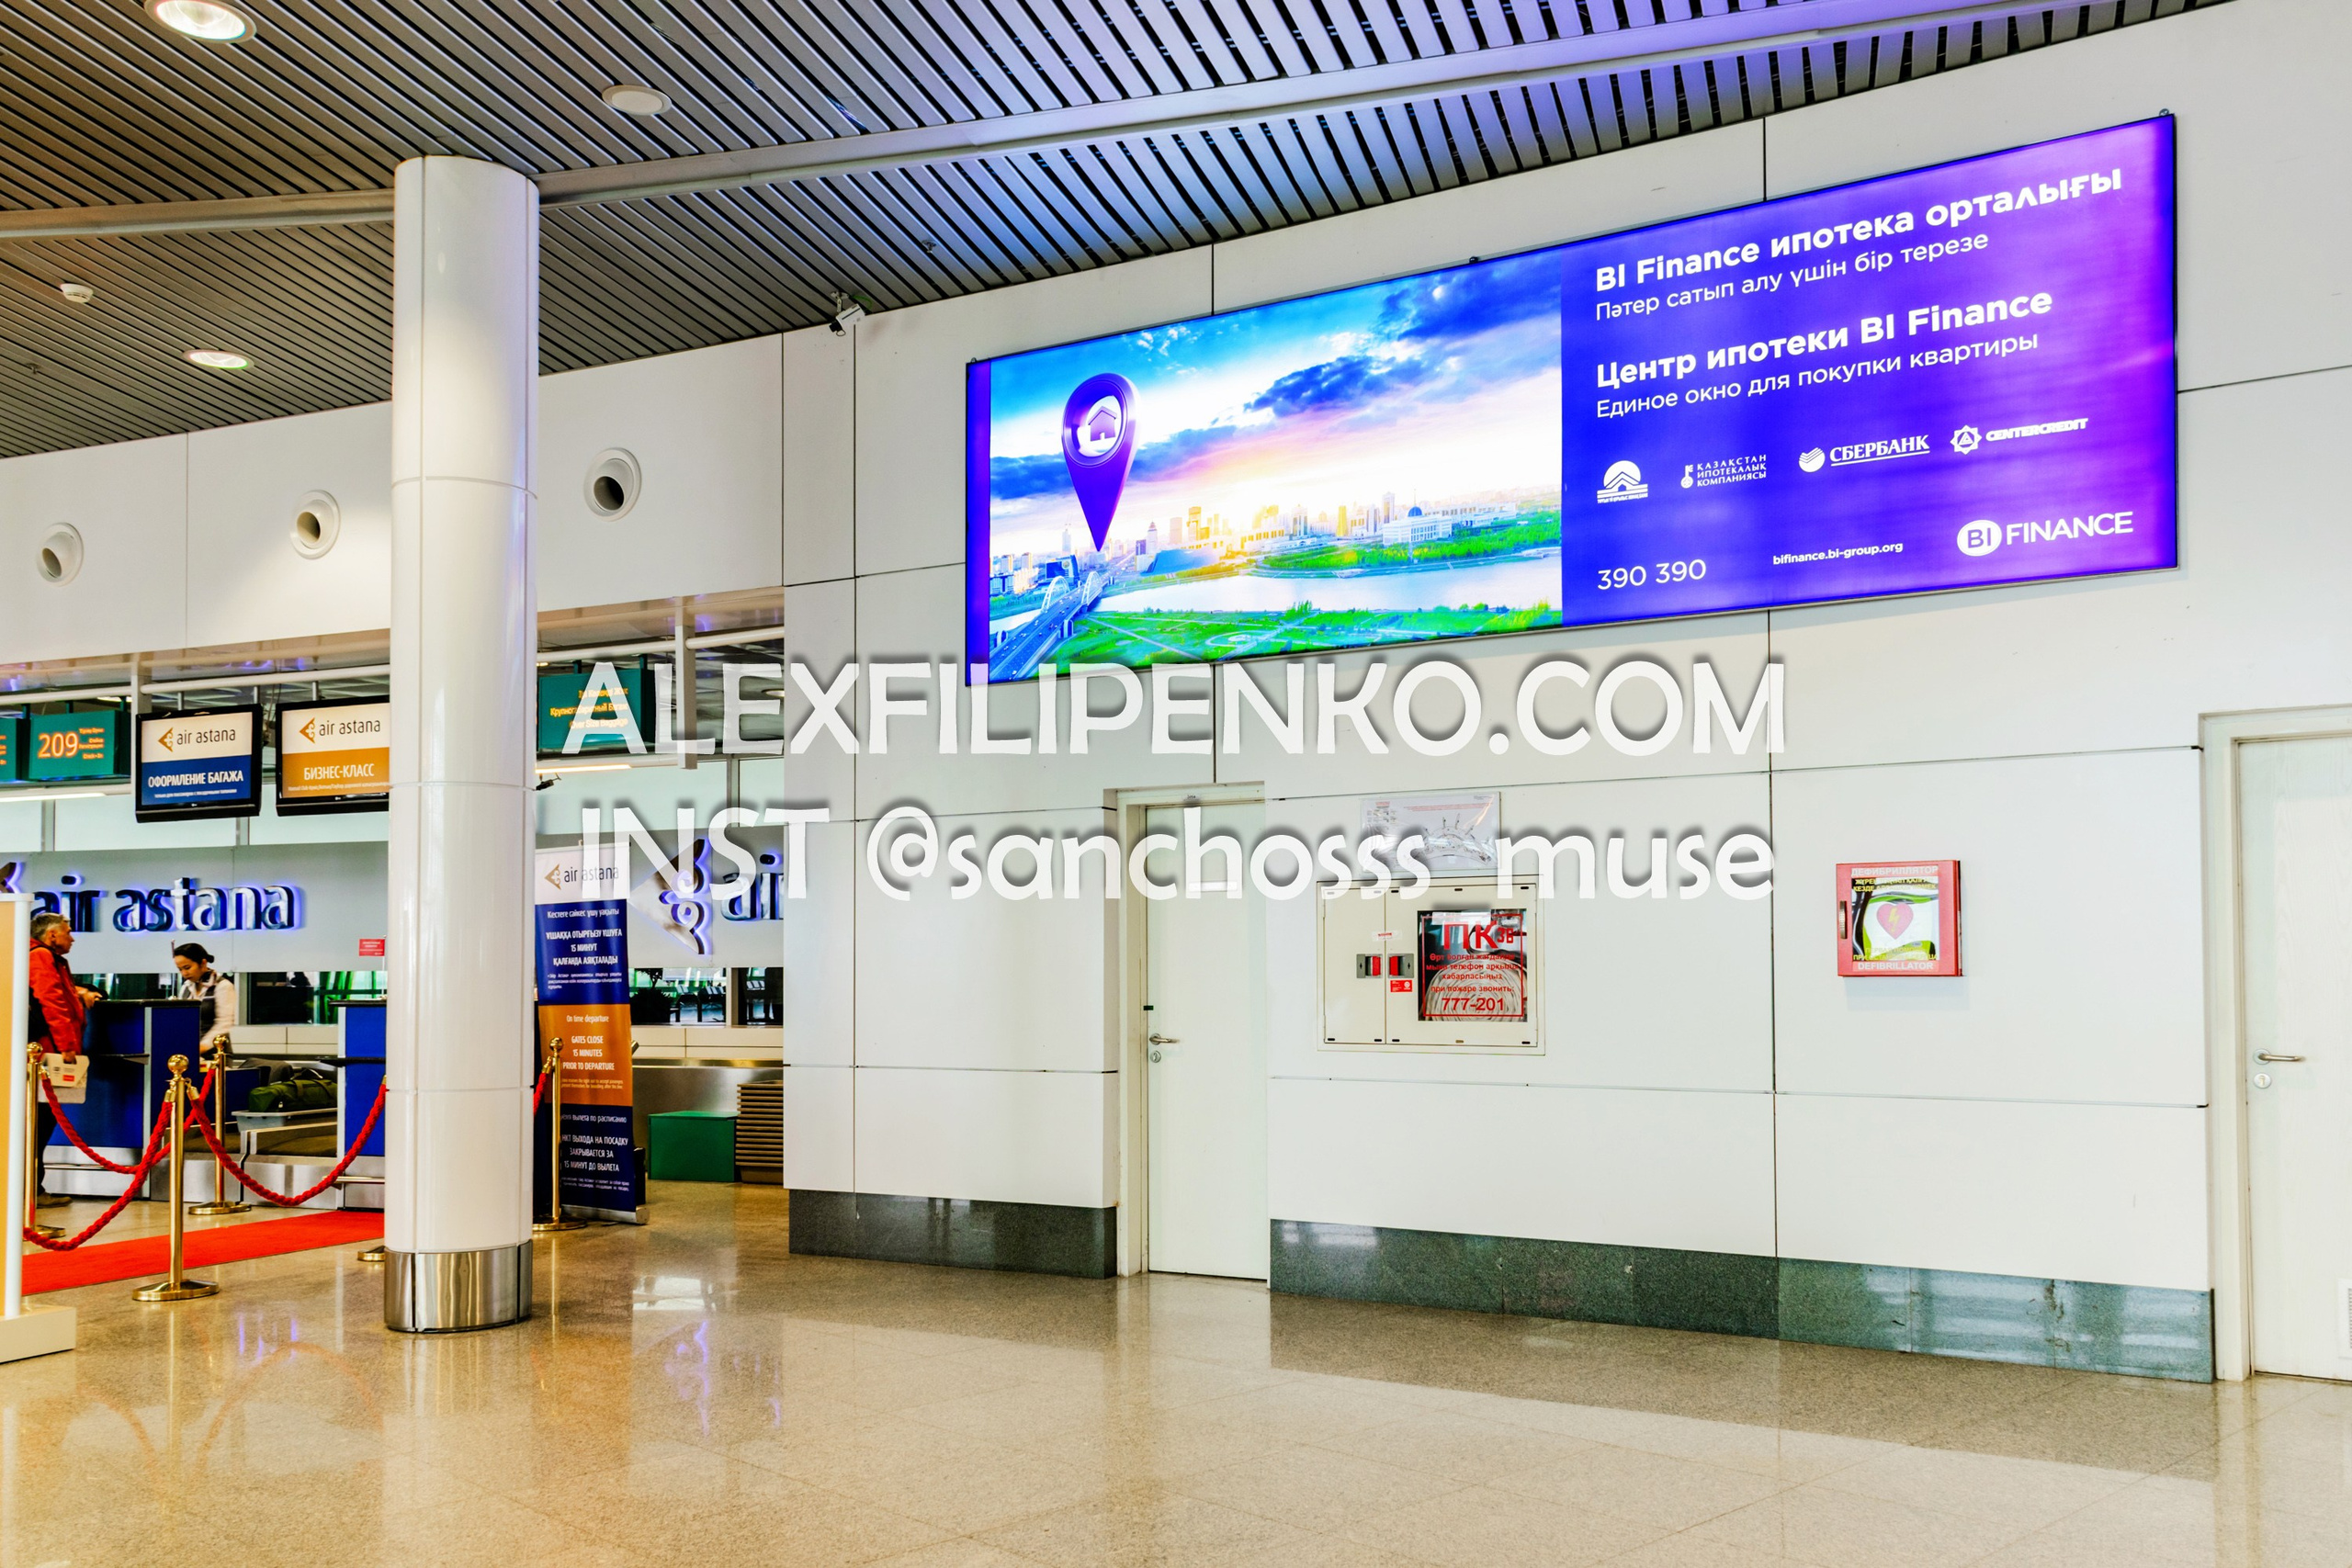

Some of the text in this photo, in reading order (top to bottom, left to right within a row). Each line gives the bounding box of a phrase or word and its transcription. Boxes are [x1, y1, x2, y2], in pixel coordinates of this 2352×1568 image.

[1597, 168, 2121, 291] BI Finance ипотека орталығы
[1597, 296, 1659, 321] Пәтер
[1667, 282, 1734, 308] сатып
[1742, 273, 1782, 294] алу
[1854, 251, 1893, 272] бір
[1900, 233, 1989, 263] терезе
[1597, 291, 2052, 389] Центр ипотеки BI Finance
[1597, 333, 2038, 419] Единое окно для покупки квартиры
[1829, 434, 1930, 463] СБЕРБАНК
[1697, 471, 1767, 487] КОМПАНИЯСЫ
[1967, 511, 2133, 549] BI FINANCE
[1773, 541, 1904, 565] bifinance.bi-group.org
[1597, 558, 1706, 590] 390 390
[176, 729, 236, 745] air astana
[319, 719, 380, 736] air astana
[38, 731, 79, 760] 209
[148, 770, 243, 787] ОФОРМЛЕНИЕ БАГАЖА
[304, 763, 375, 780] БИЗНЕС-КЛАСС
[564, 866, 618, 883] air astana
[112, 877, 295, 932] astana
[1443, 920, 1498, 950] ПК
[1450, 963, 1484, 972] телефон
[1442, 997, 1504, 1011] 777-201
[586, 1035, 604, 1043] CLOSE
[594, 1136, 603, 1145] НА
[606, 1149, 614, 1158] ЗА
